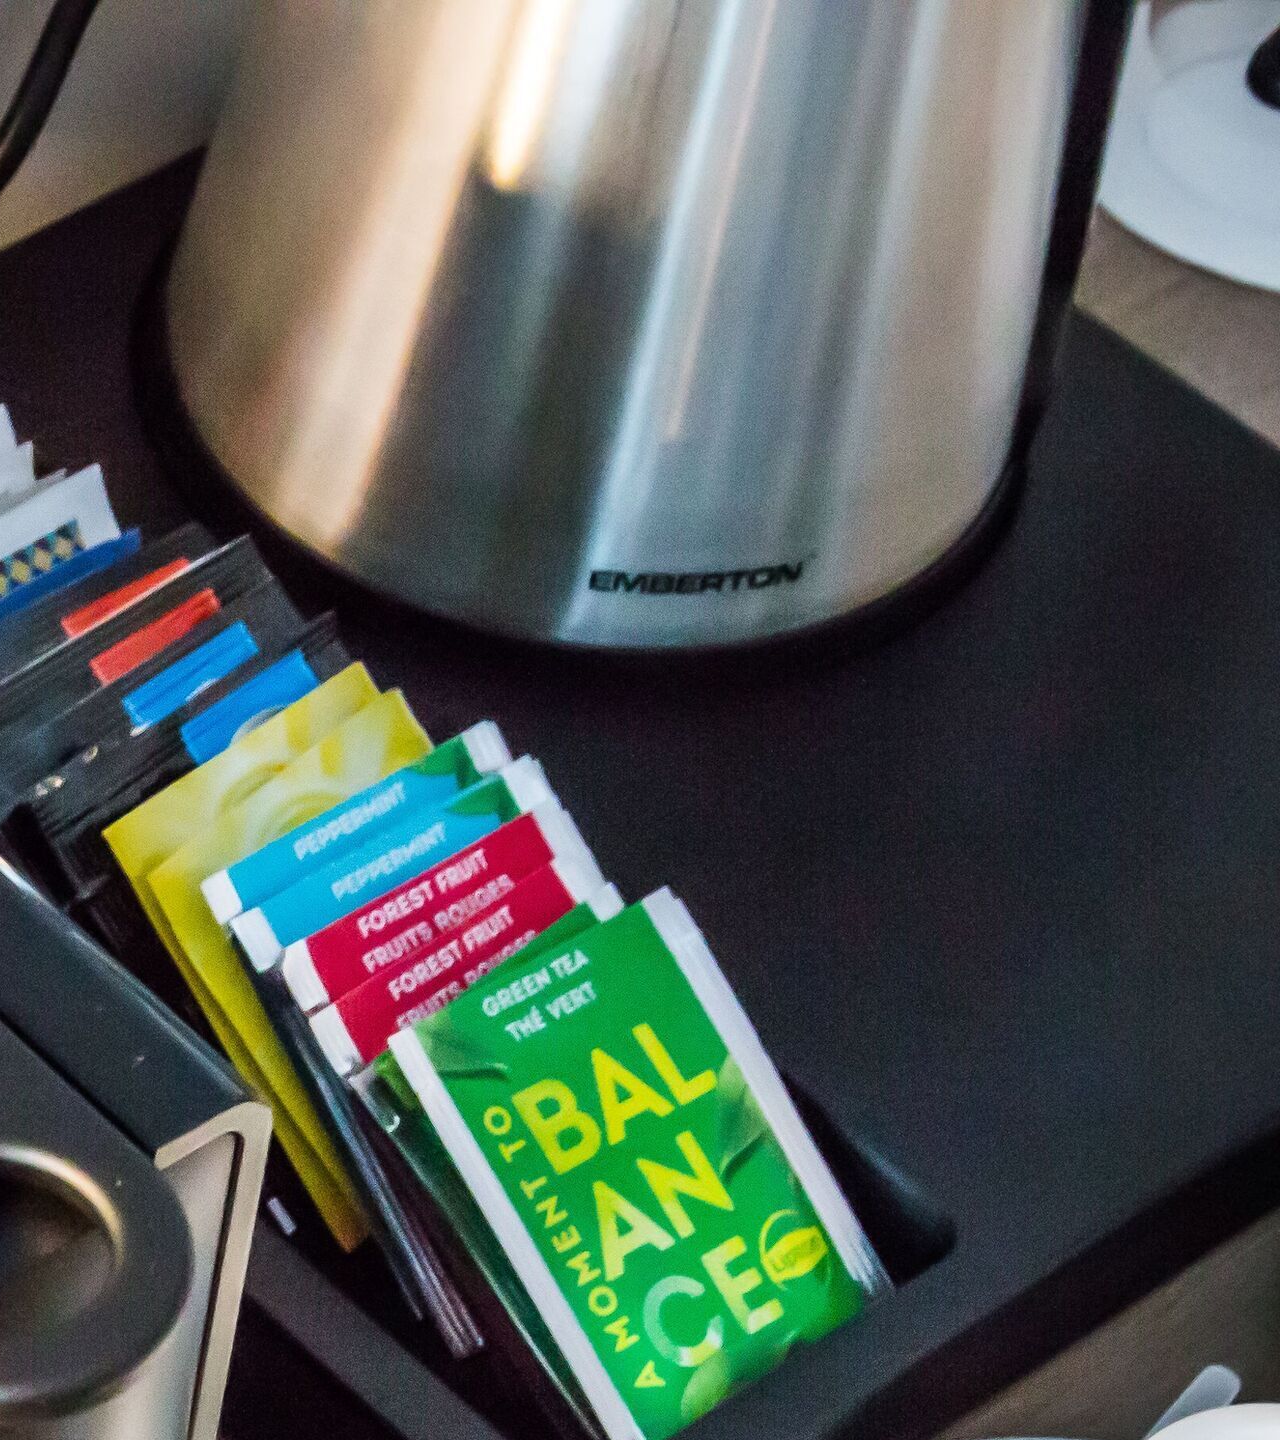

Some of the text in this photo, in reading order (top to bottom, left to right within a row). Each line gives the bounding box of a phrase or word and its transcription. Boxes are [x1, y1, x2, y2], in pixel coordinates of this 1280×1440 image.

[589, 562, 804, 594] EMBERTON
[293, 781, 406, 861] PEPPERMINT
[331, 821, 445, 902] PEPPERMINT
[357, 848, 488, 939] FOREST FRUIT
[361, 873, 516, 973] FRUITS ROUGES
[387, 905, 514, 1001] FOREST FRUIT
[482, 949, 589, 1017] GREEN TEA
[546, 980, 597, 1020] VERT
[512, 1023, 716, 1174] BAL
[483, 1105, 666, 1388] A MOMENT TO
[592, 1130, 734, 1282] AN
[642, 1236, 784, 1367] CE
